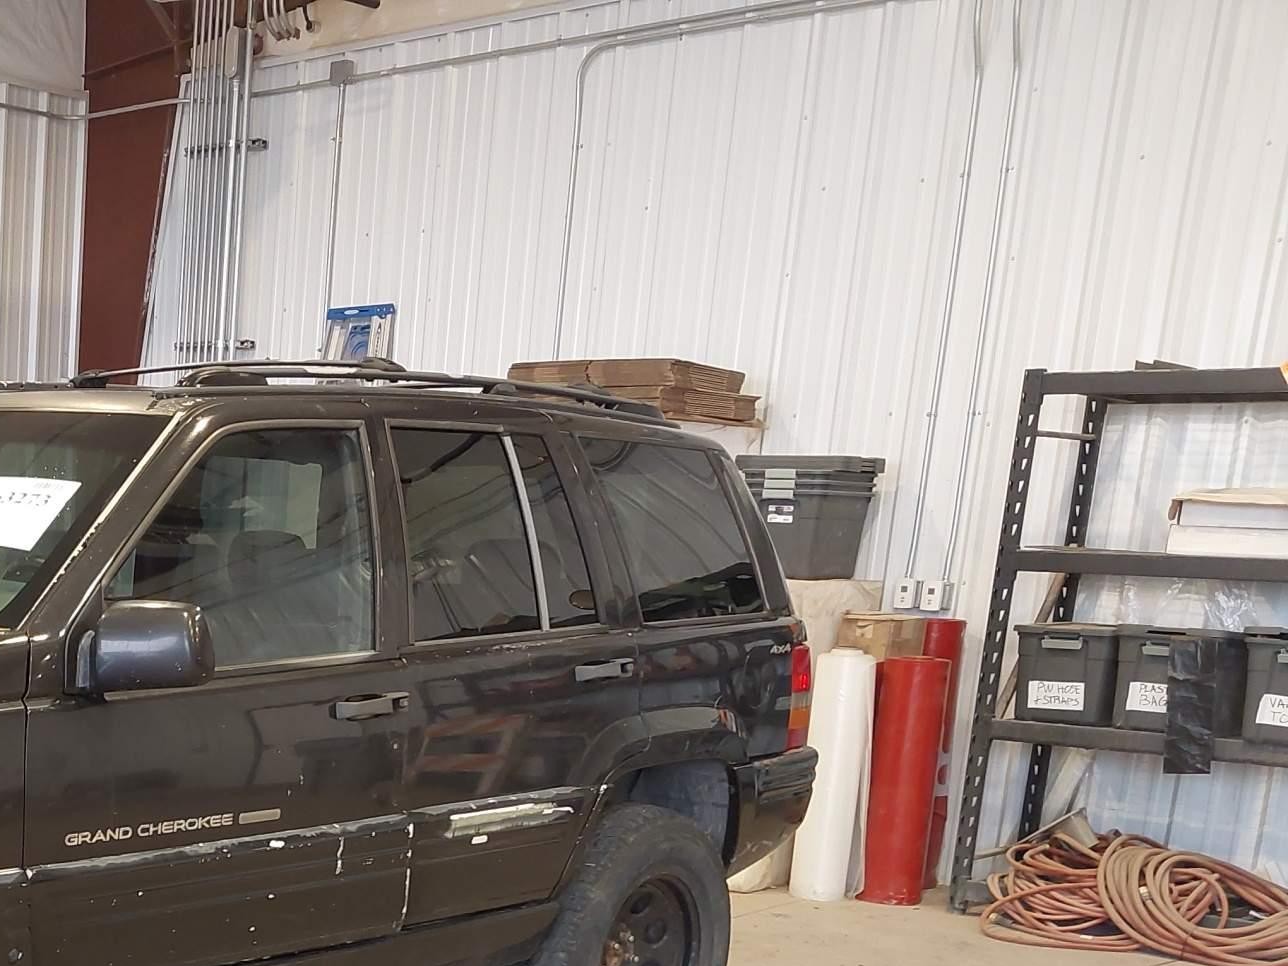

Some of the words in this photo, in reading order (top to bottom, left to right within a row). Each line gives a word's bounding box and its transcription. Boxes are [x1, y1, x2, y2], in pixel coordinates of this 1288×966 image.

[1057, 684, 1081, 695] HOSE
[64, 826, 133, 846] GRAND
[137, 813, 234, 837] CHEROKEE
